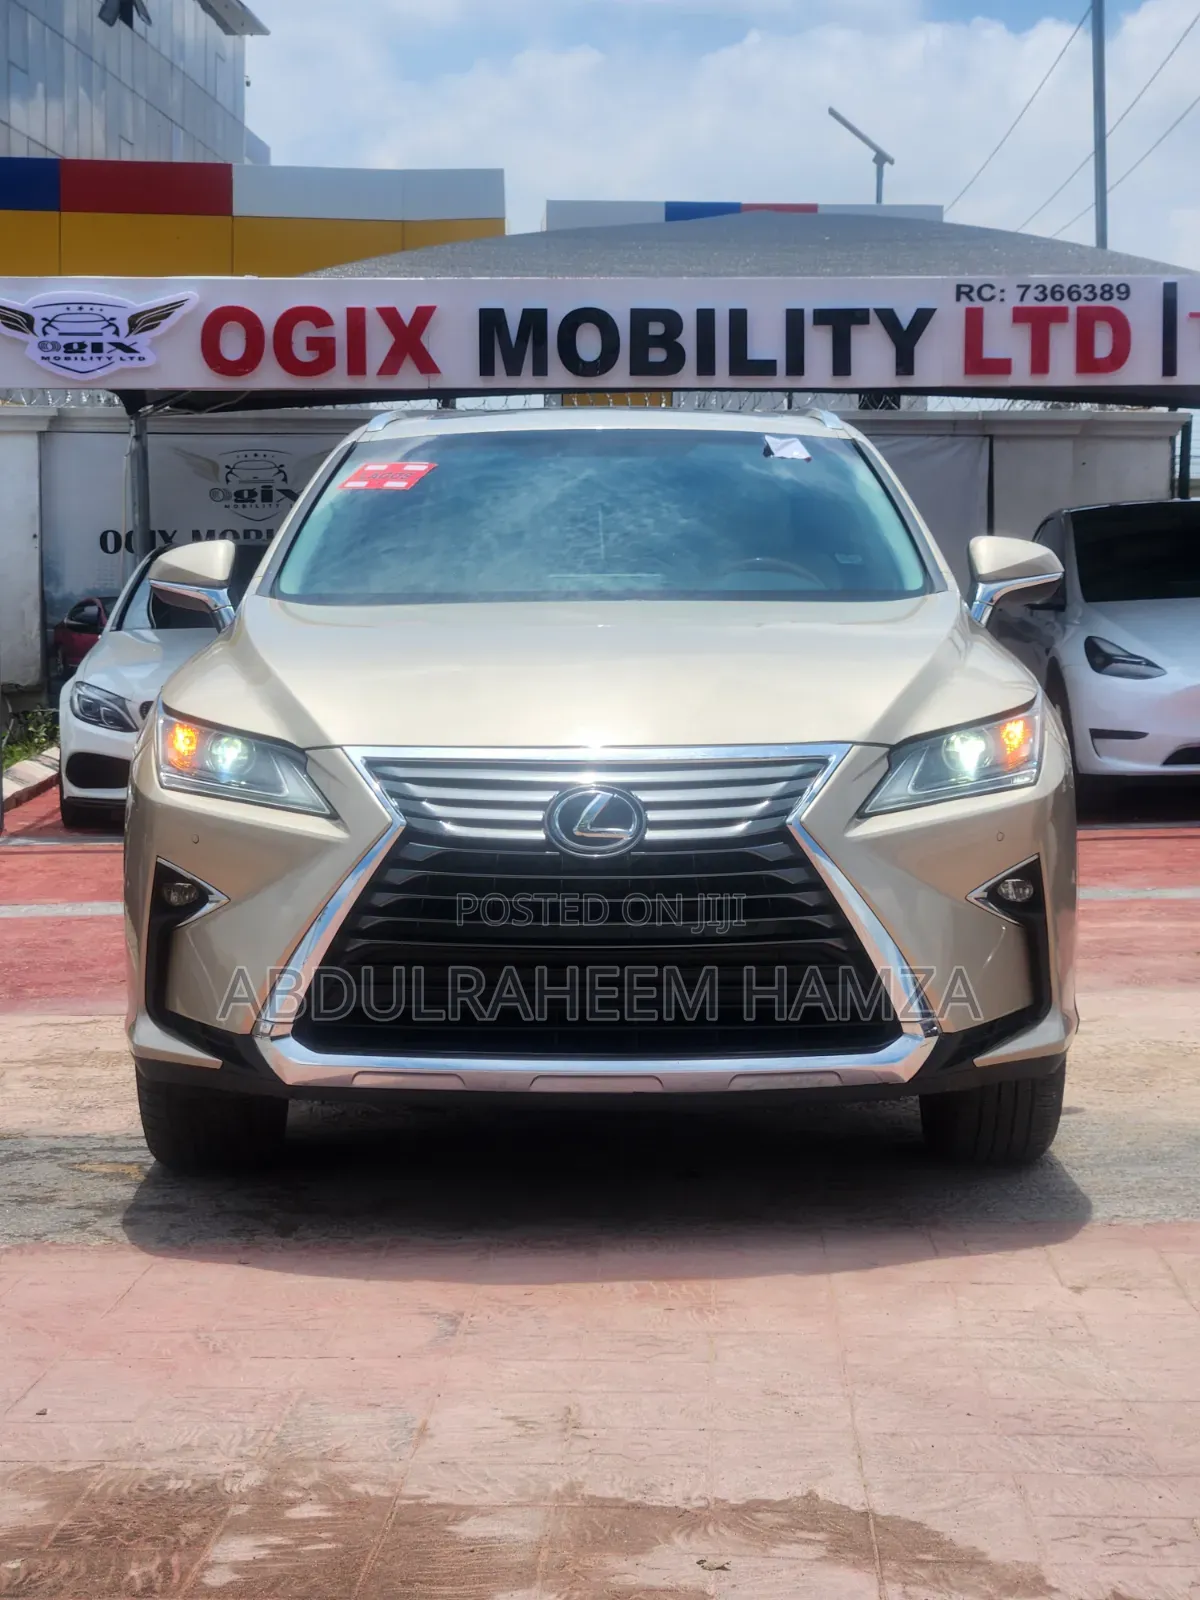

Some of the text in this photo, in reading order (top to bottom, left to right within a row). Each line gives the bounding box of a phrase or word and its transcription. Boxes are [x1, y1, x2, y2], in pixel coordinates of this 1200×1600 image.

[955, 283, 1131, 303] RC: 7366389
[200, 305, 1132, 378] OGIX MOBILITY LTD
